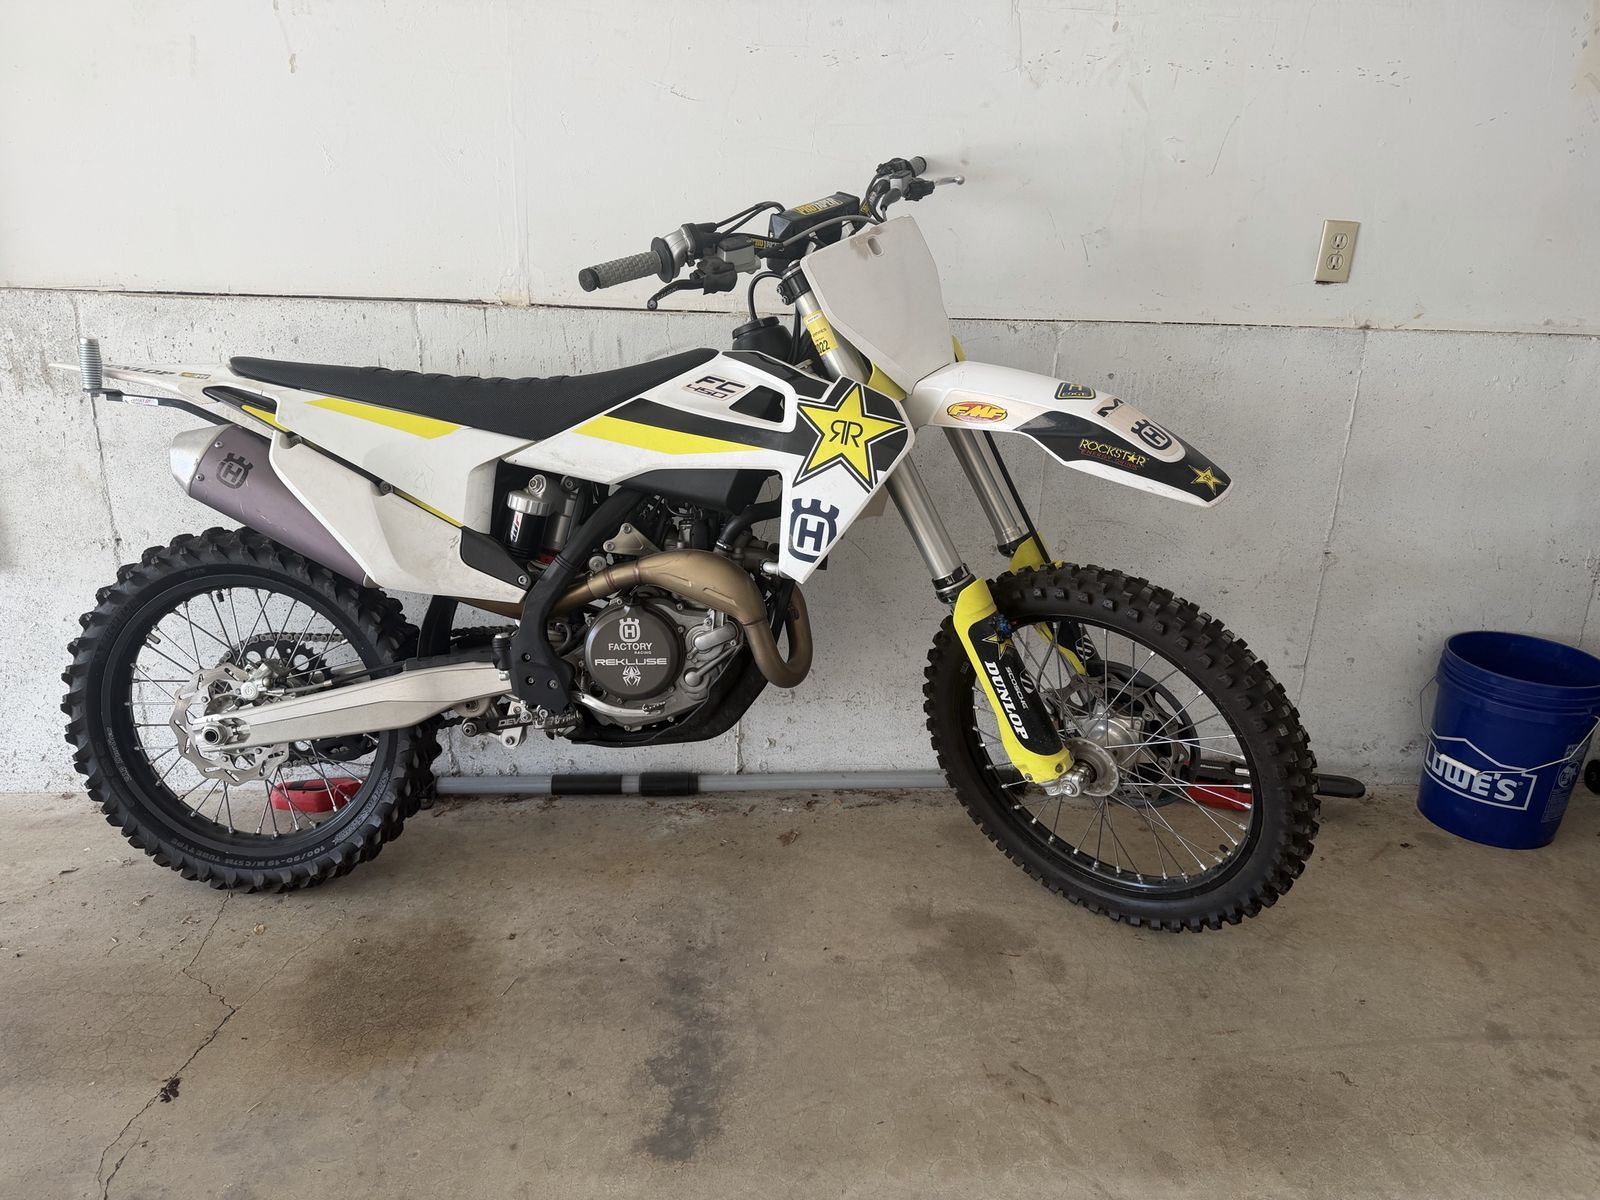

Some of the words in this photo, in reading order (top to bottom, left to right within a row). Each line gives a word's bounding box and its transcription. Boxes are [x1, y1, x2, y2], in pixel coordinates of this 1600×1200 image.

[686, 384, 728, 399] 450
[695, 376, 746, 393] FC
[948, 405, 1007, 420] FMF
[608, 642, 653, 651] FACTORY
[594, 657, 668, 666] REKLUSE
[984, 660, 1029, 740] DUNLOP
[1426, 743, 1518, 802] LOWE'S
